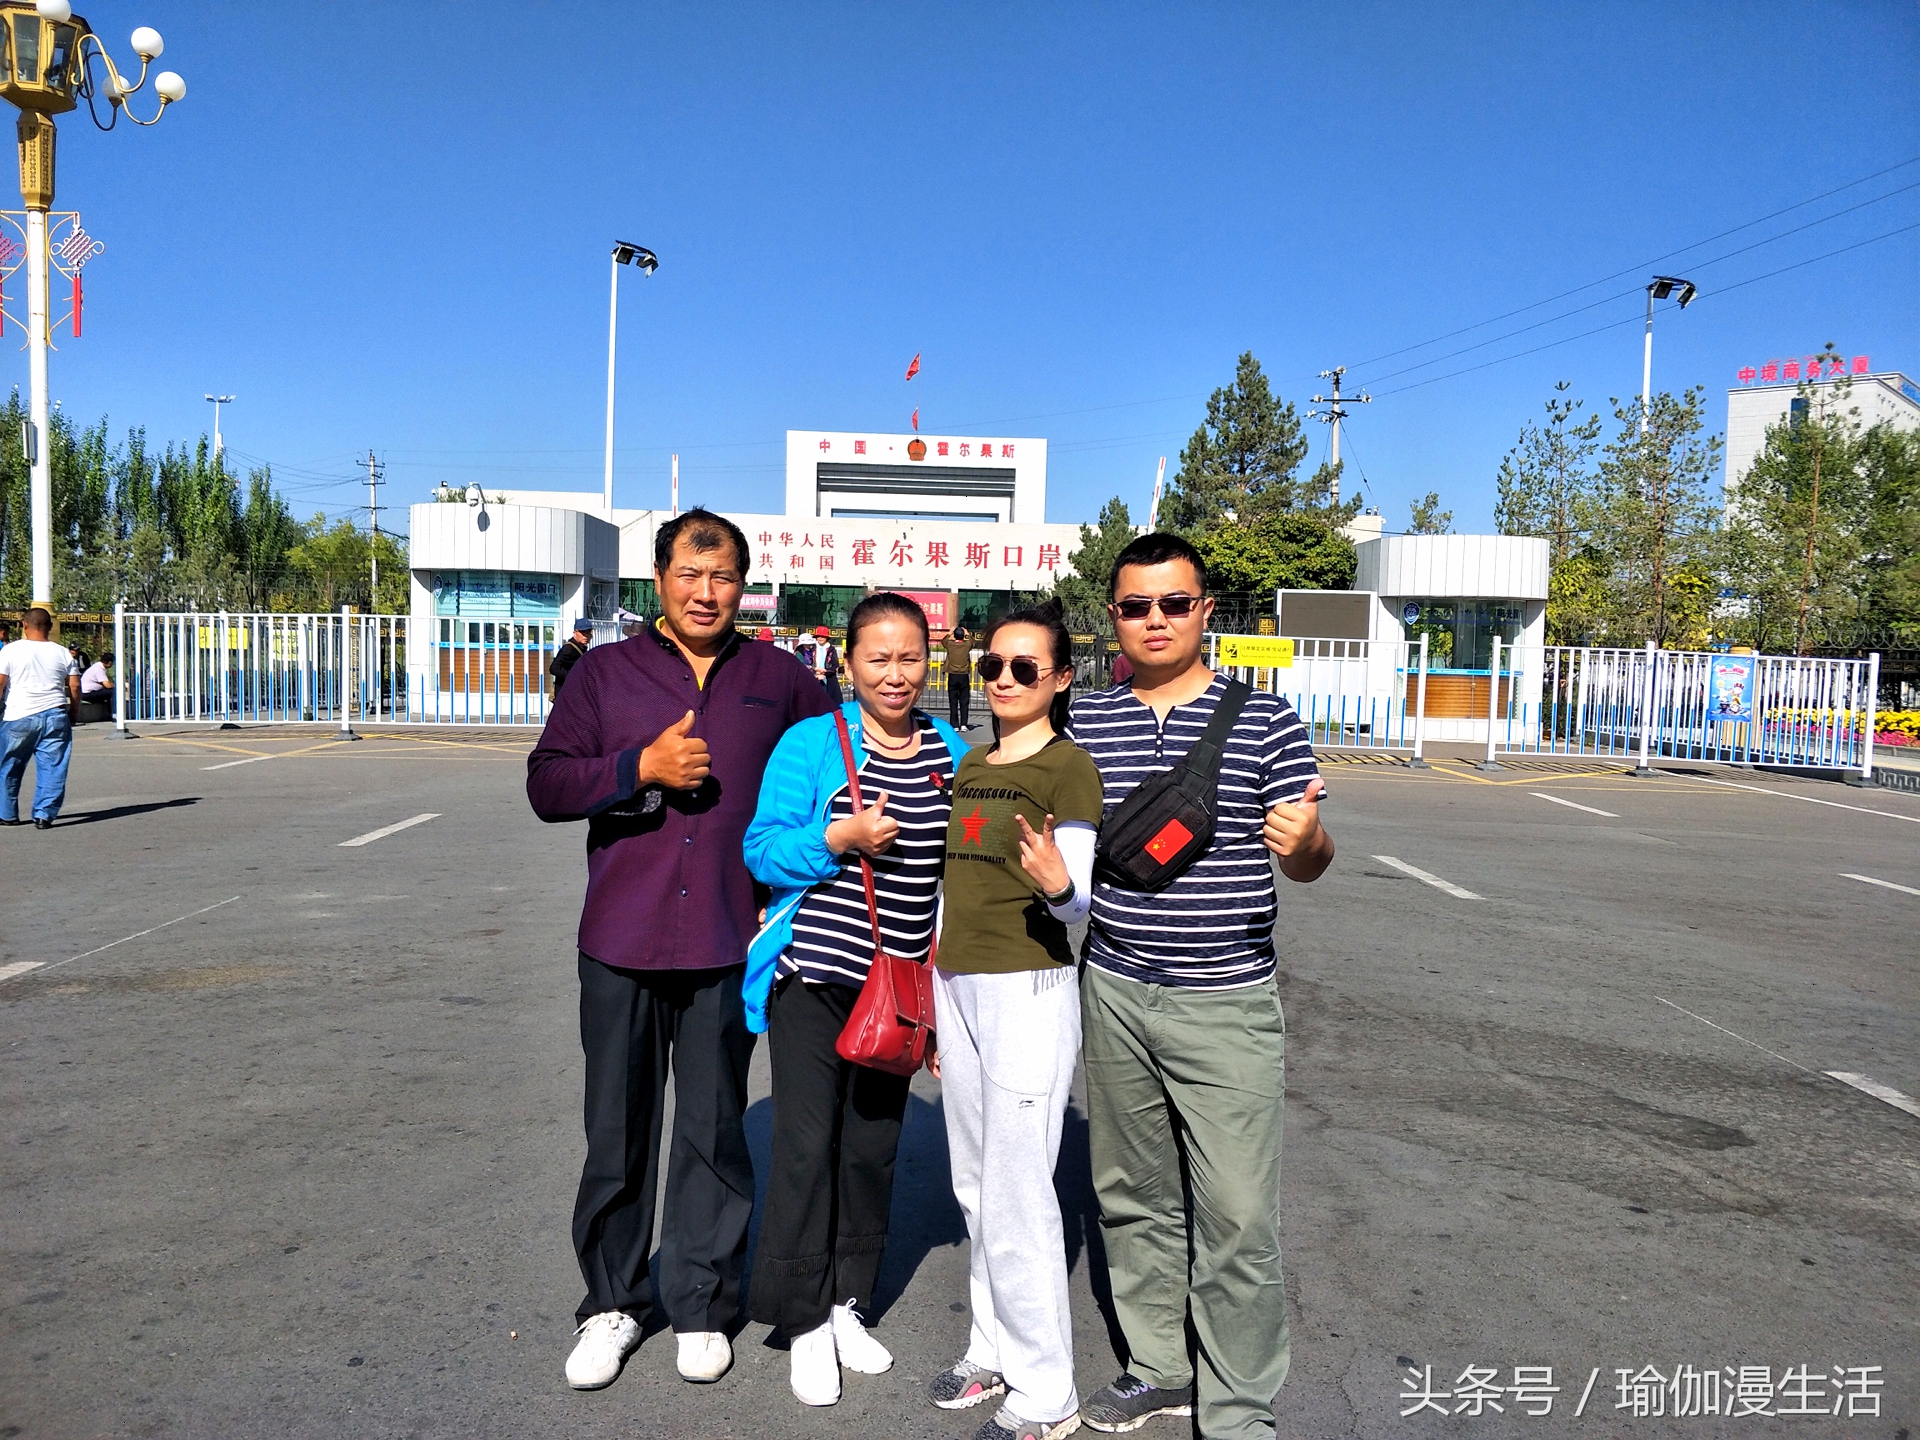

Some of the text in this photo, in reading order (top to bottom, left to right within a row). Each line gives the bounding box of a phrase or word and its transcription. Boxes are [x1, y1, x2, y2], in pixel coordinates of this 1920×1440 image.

[759, 531, 834, 549] 中华人民
[759, 553, 834, 570] 共和国
[852, 539, 1061, 571] 霍尔果斯口岸
